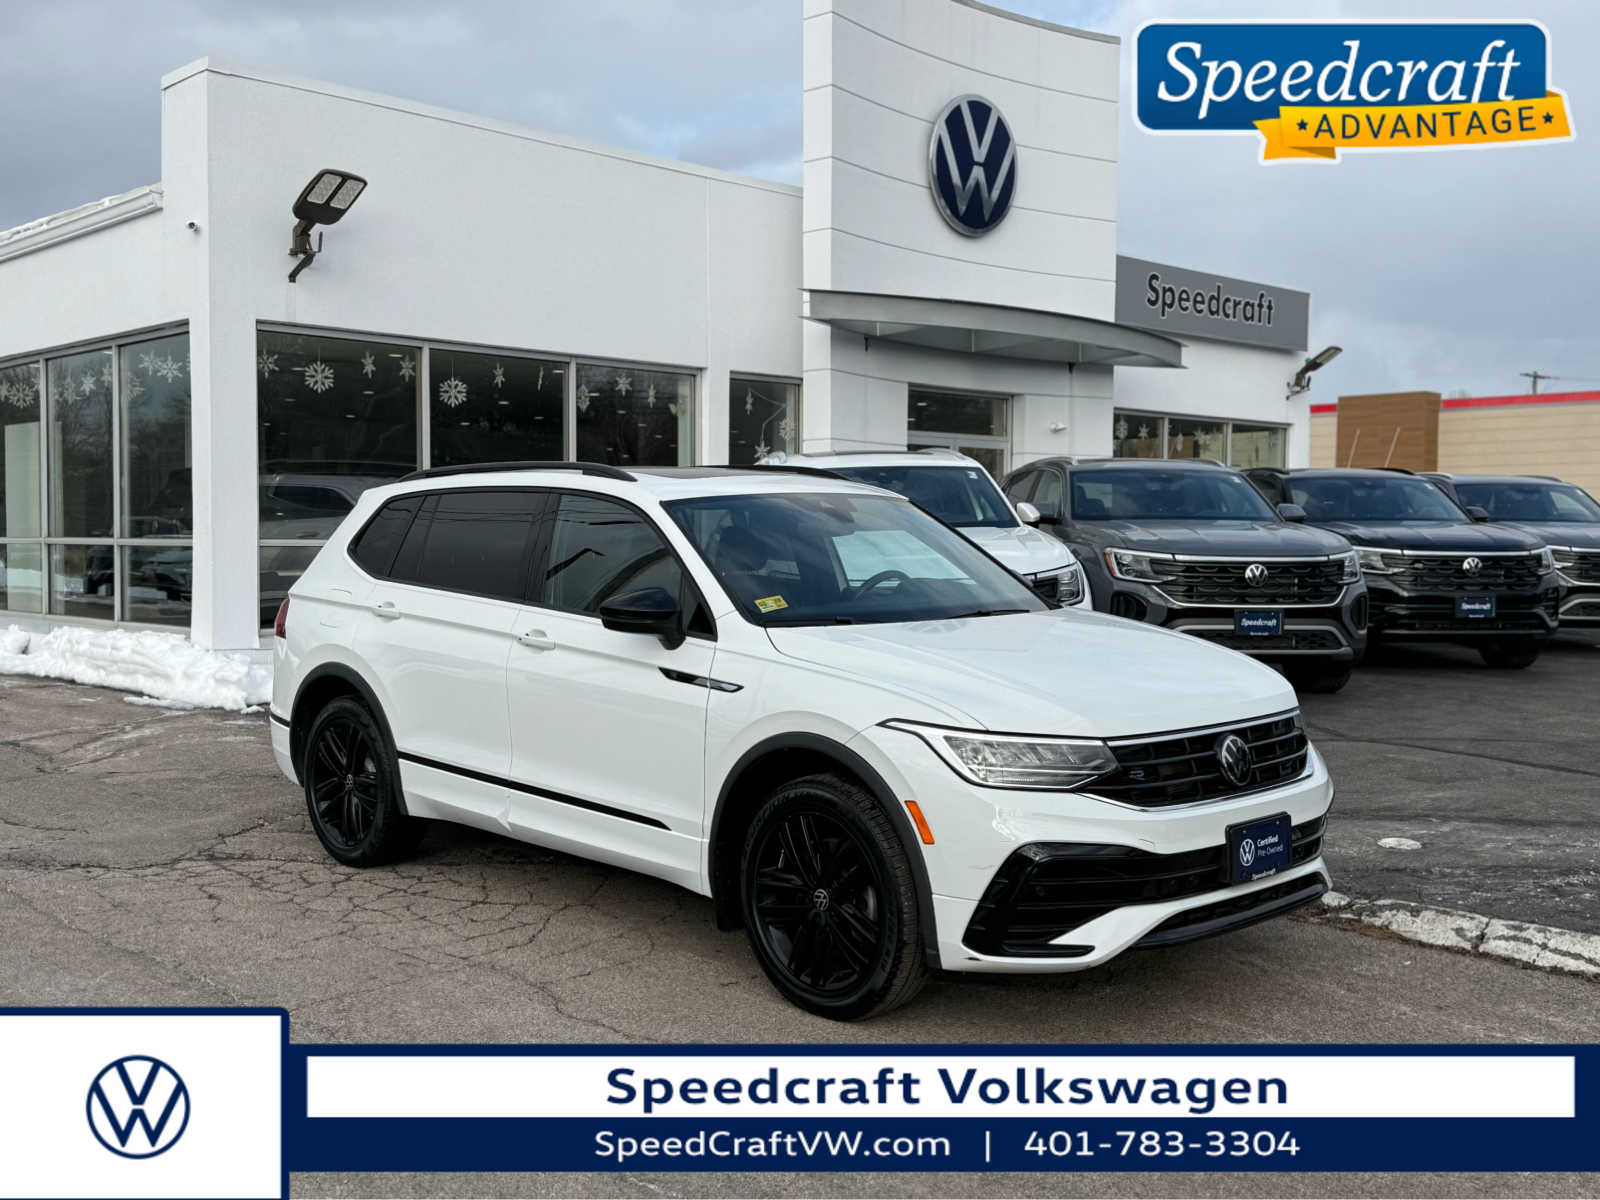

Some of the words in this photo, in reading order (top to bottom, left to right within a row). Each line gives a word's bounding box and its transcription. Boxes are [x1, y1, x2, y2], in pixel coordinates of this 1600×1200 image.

[1147, 272, 1274, 325] Speedcraft
[1241, 618, 1277, 628] Speedcraft
[1257, 834, 1279, 847] Certified
